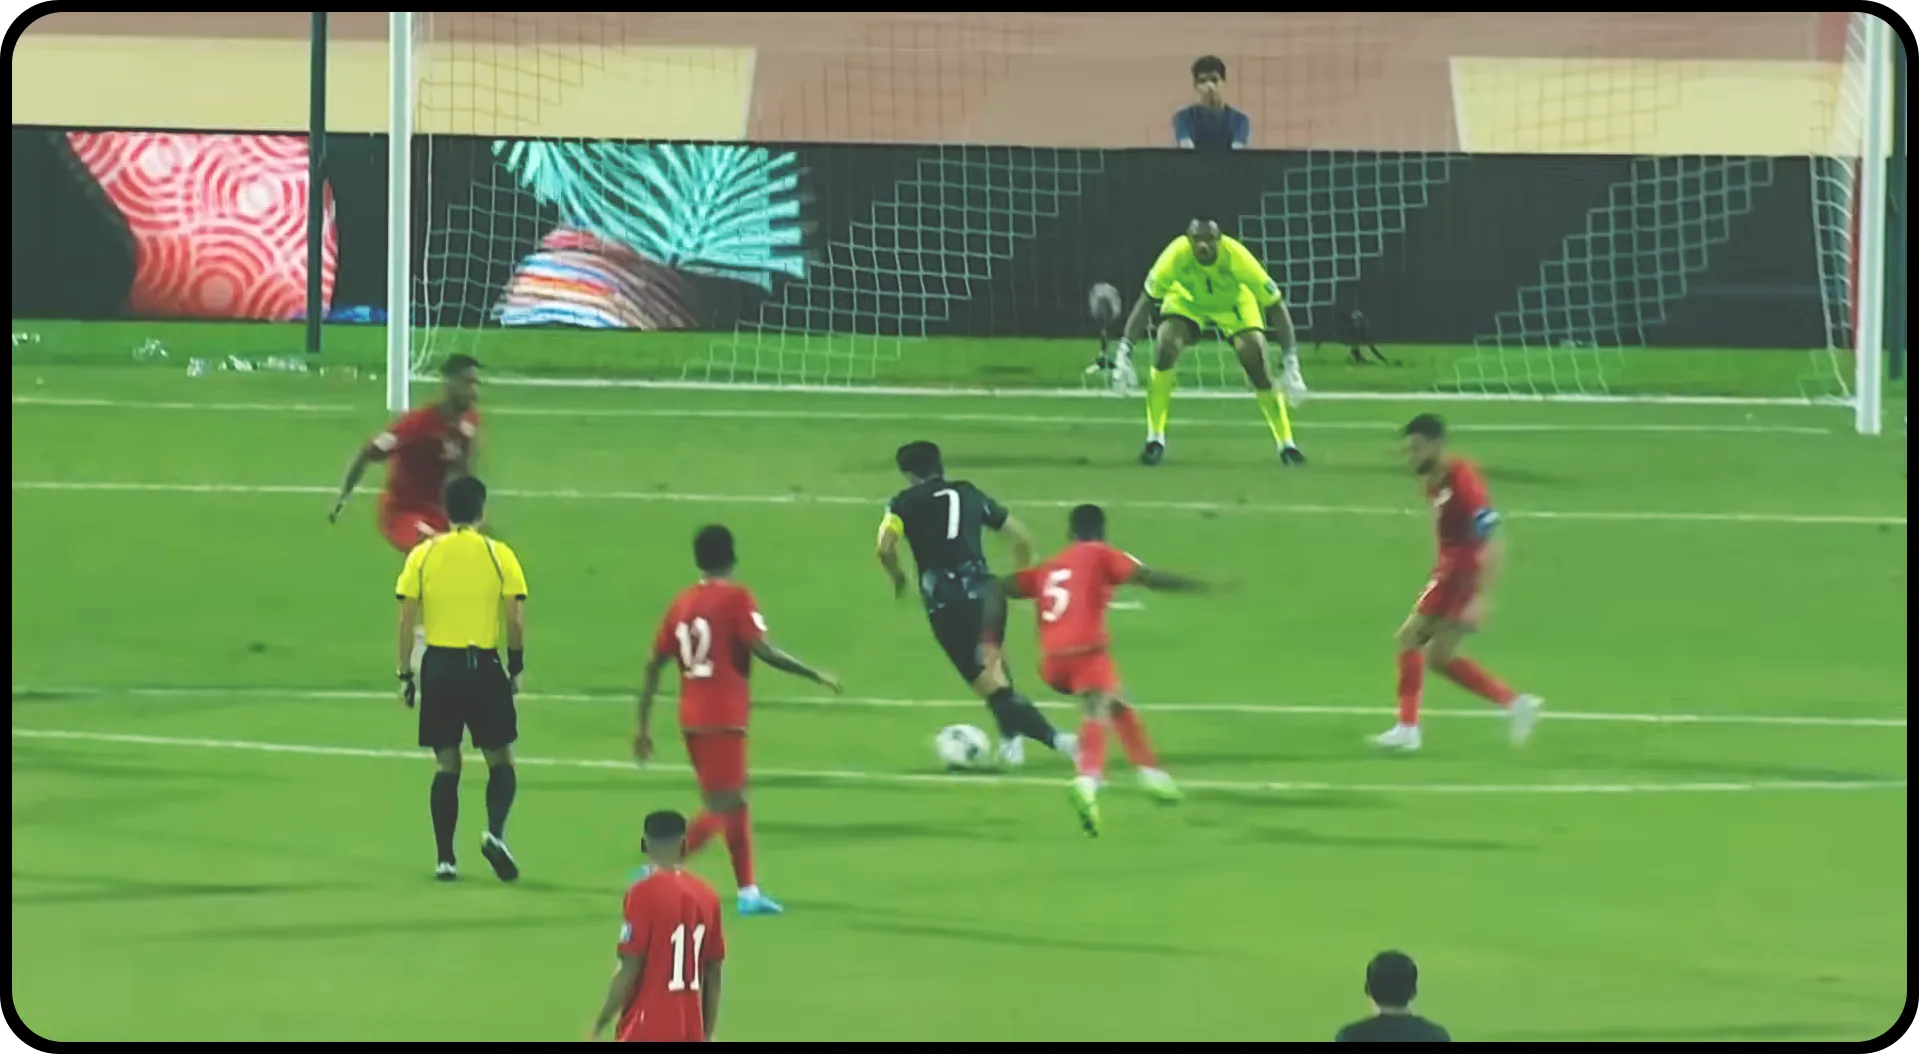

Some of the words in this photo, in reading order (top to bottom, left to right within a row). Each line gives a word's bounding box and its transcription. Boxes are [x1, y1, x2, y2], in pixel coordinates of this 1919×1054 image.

[933, 488, 961, 540] 7
[1041, 568, 1073, 622] 5
[675, 616, 714, 679] 12
[668, 923, 706, 991] 11
